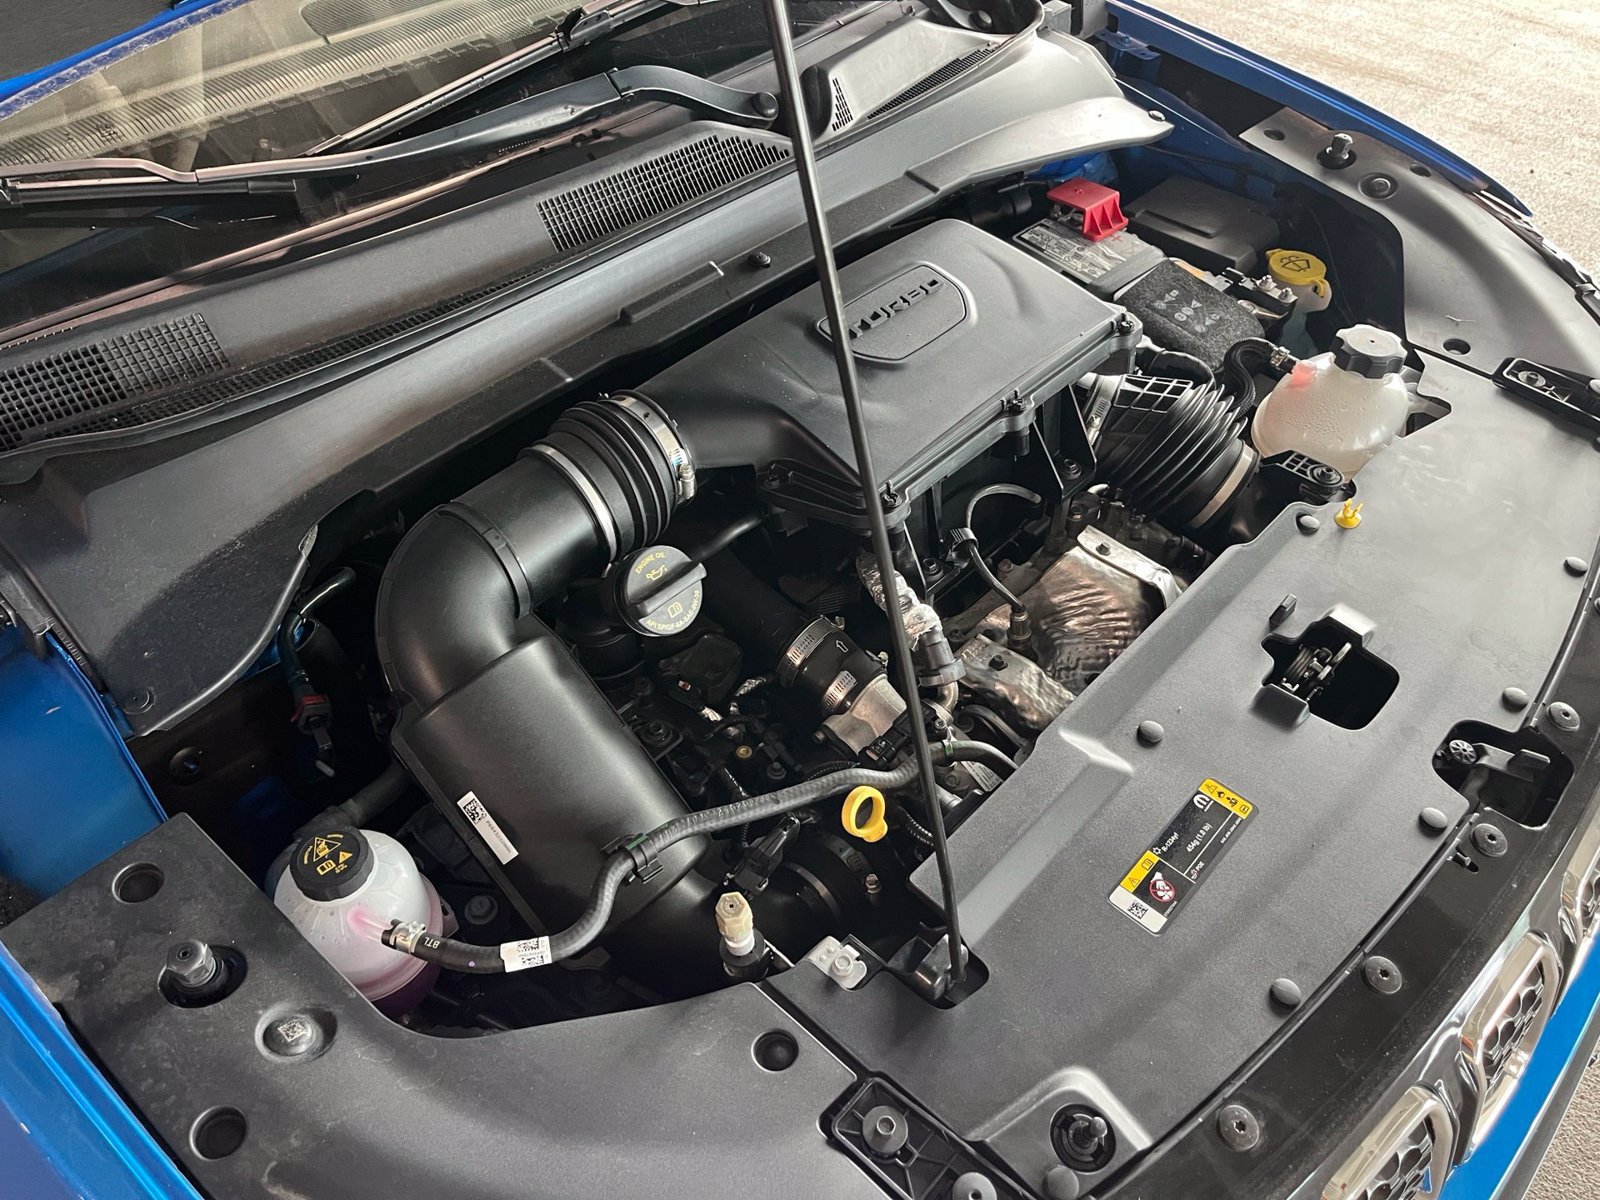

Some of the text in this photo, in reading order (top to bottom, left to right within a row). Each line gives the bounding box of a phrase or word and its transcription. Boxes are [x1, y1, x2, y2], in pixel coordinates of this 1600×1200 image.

[635, 553, 656, 574] ENGINE
[646, 619, 658, 629] API
[1161, 832, 1179, 852] R-1234yf
[1186, 839, 1200, 852] 454g
[424, 936, 440, 949] BTL
